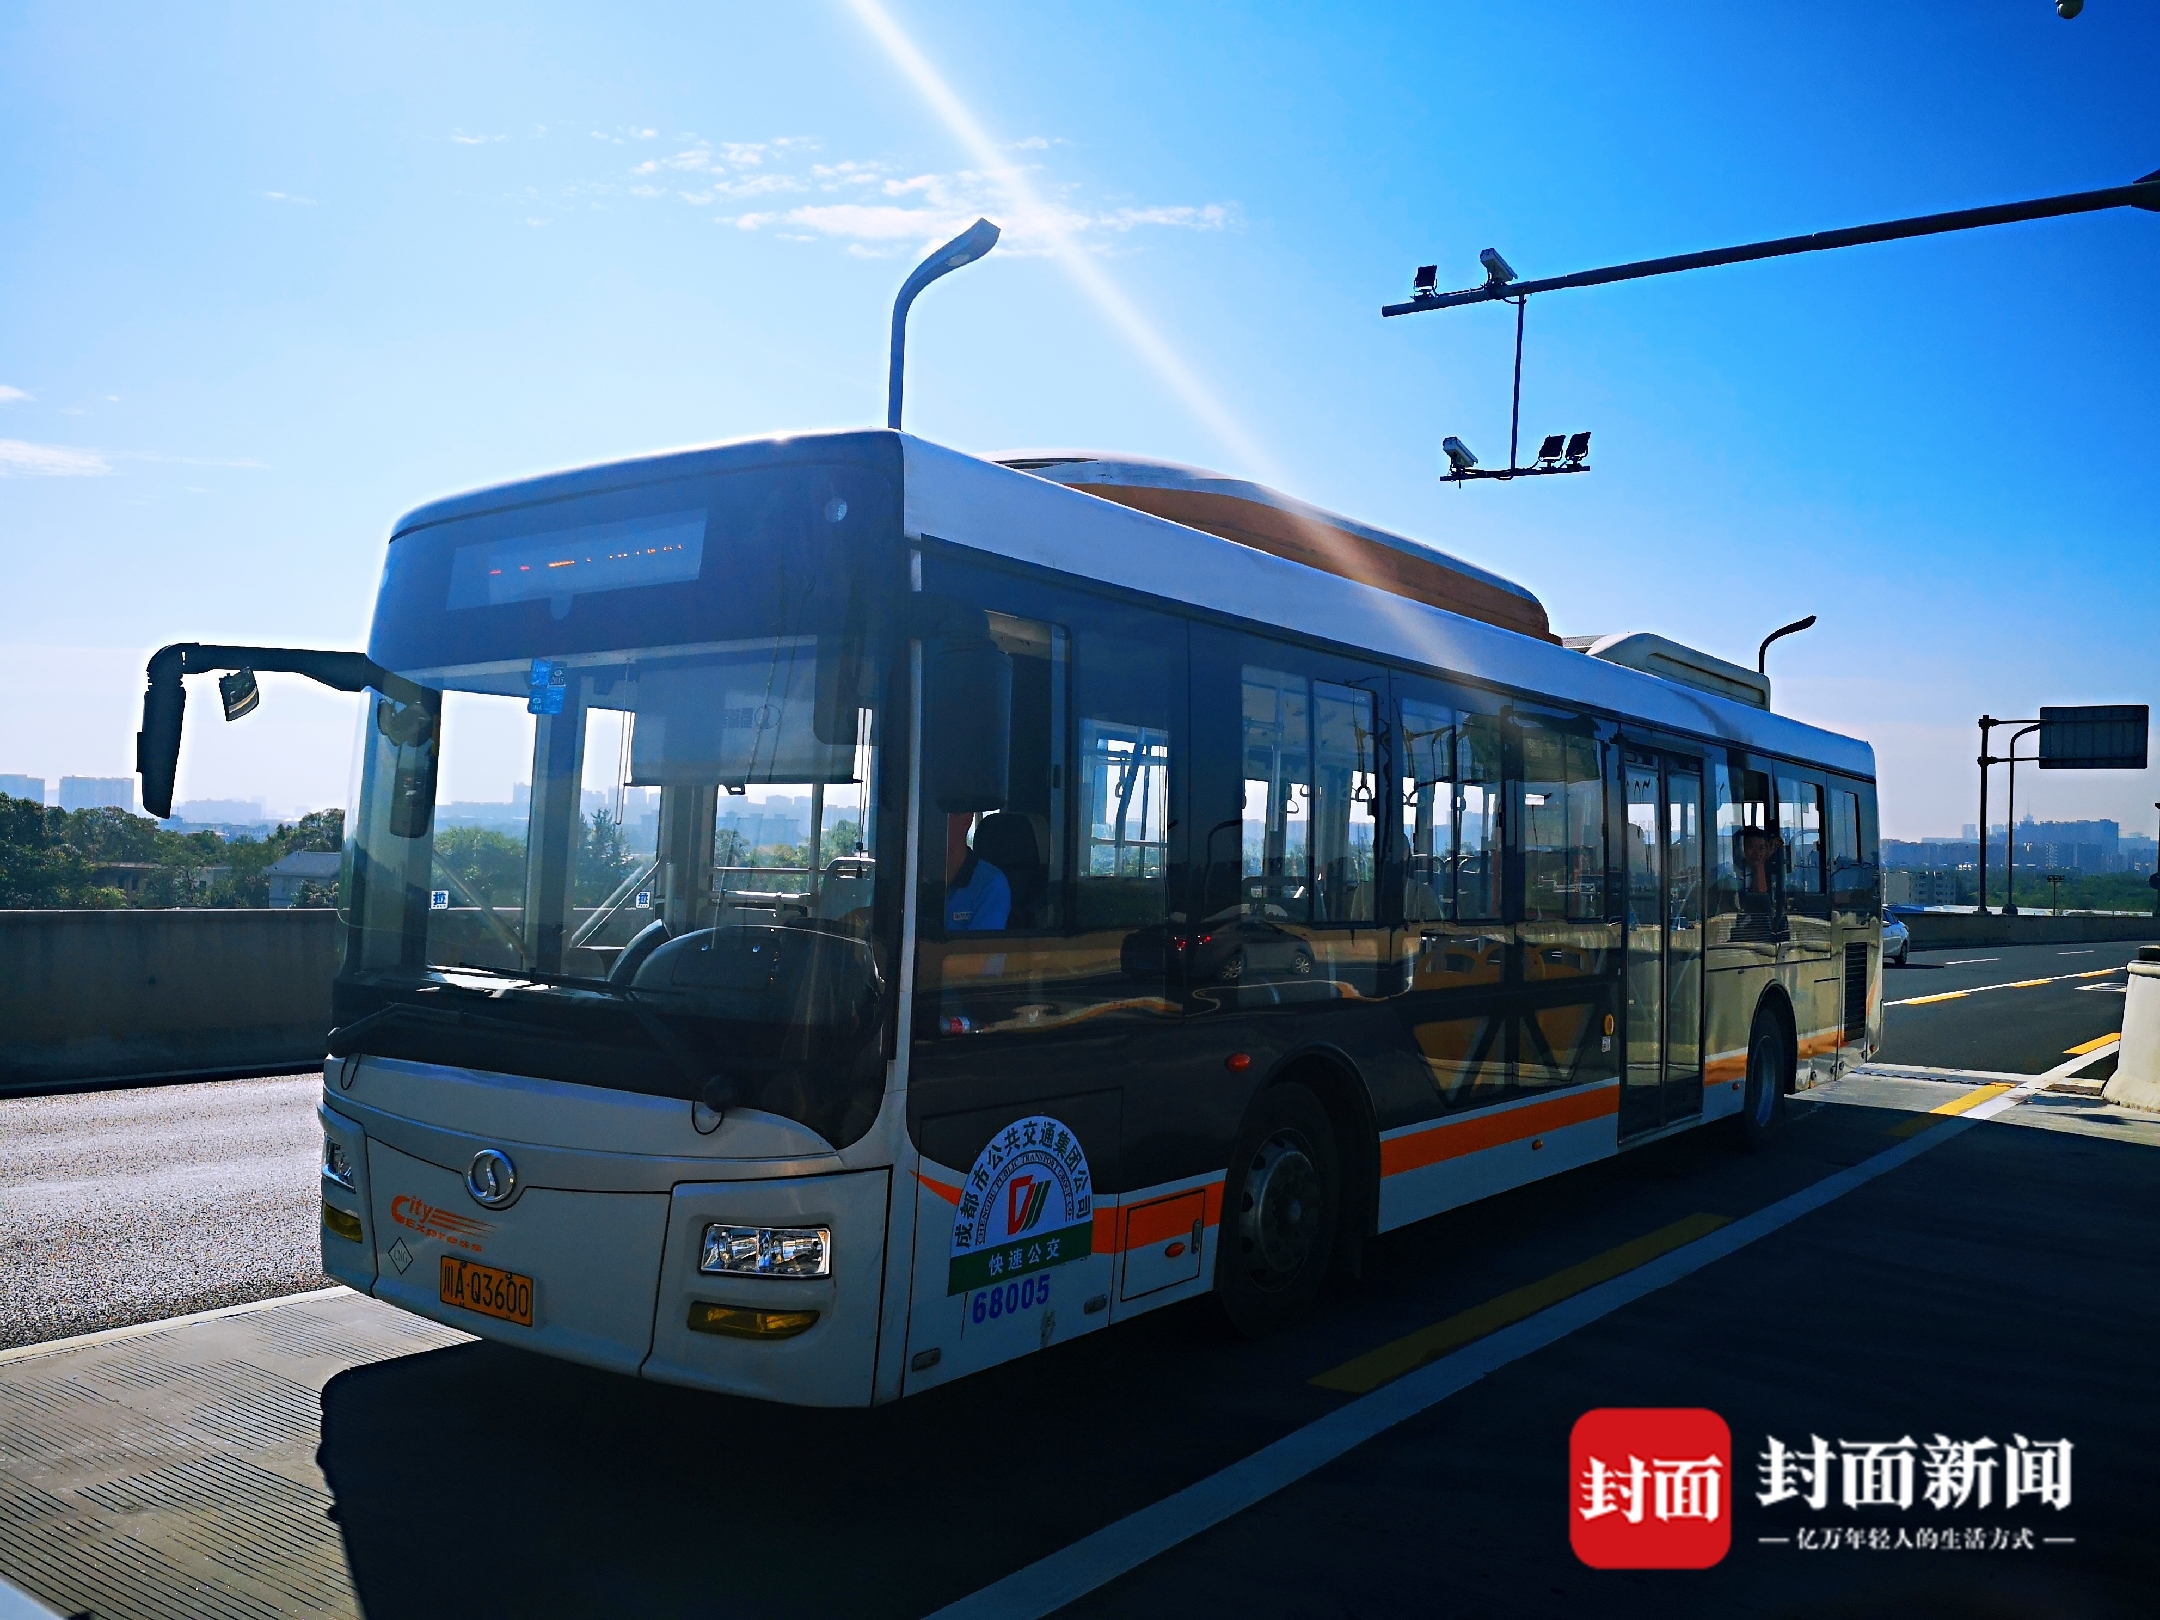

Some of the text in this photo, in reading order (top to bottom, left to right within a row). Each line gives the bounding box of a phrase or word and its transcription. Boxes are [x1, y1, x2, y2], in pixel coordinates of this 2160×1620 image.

[954, 1120, 1091, 1249] 成都市公共交通集团公司
[391, 1195, 434, 1224] City
[404, 1217, 483, 1253] Express
[988, 1238, 1061, 1277] 快速公交
[972, 1273, 1050, 1324] 68005
